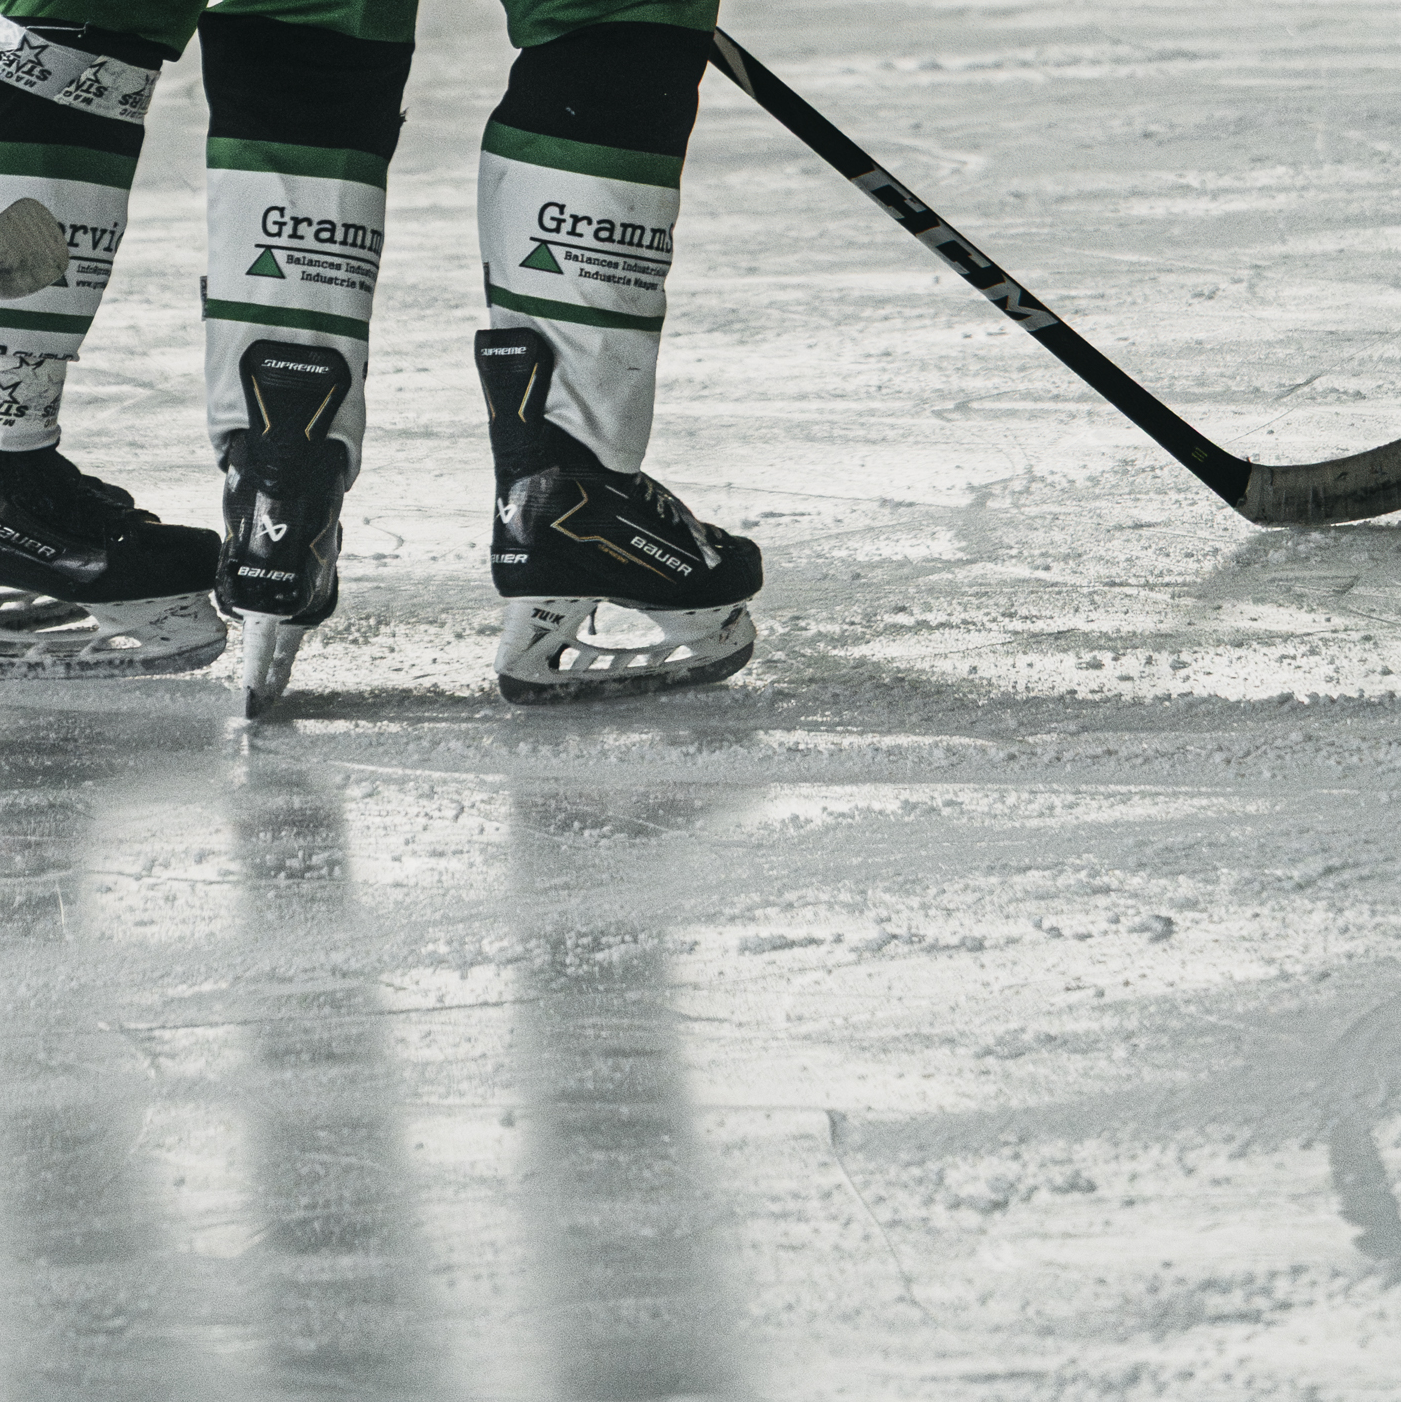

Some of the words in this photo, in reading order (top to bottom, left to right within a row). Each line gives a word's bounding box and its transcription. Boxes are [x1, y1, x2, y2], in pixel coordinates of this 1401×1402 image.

[285, 254, 342, 271] Balances
[564, 250, 620, 270] Balances
[300, 270, 357, 289] Industrie
[578, 268, 632, 286] Industrie
[481, 344, 527, 357] SUPREME
[260, 358, 330, 375] SUPREME
[629, 535, 693, 577] BAUER
[237, 565, 297, 583] BAUER
